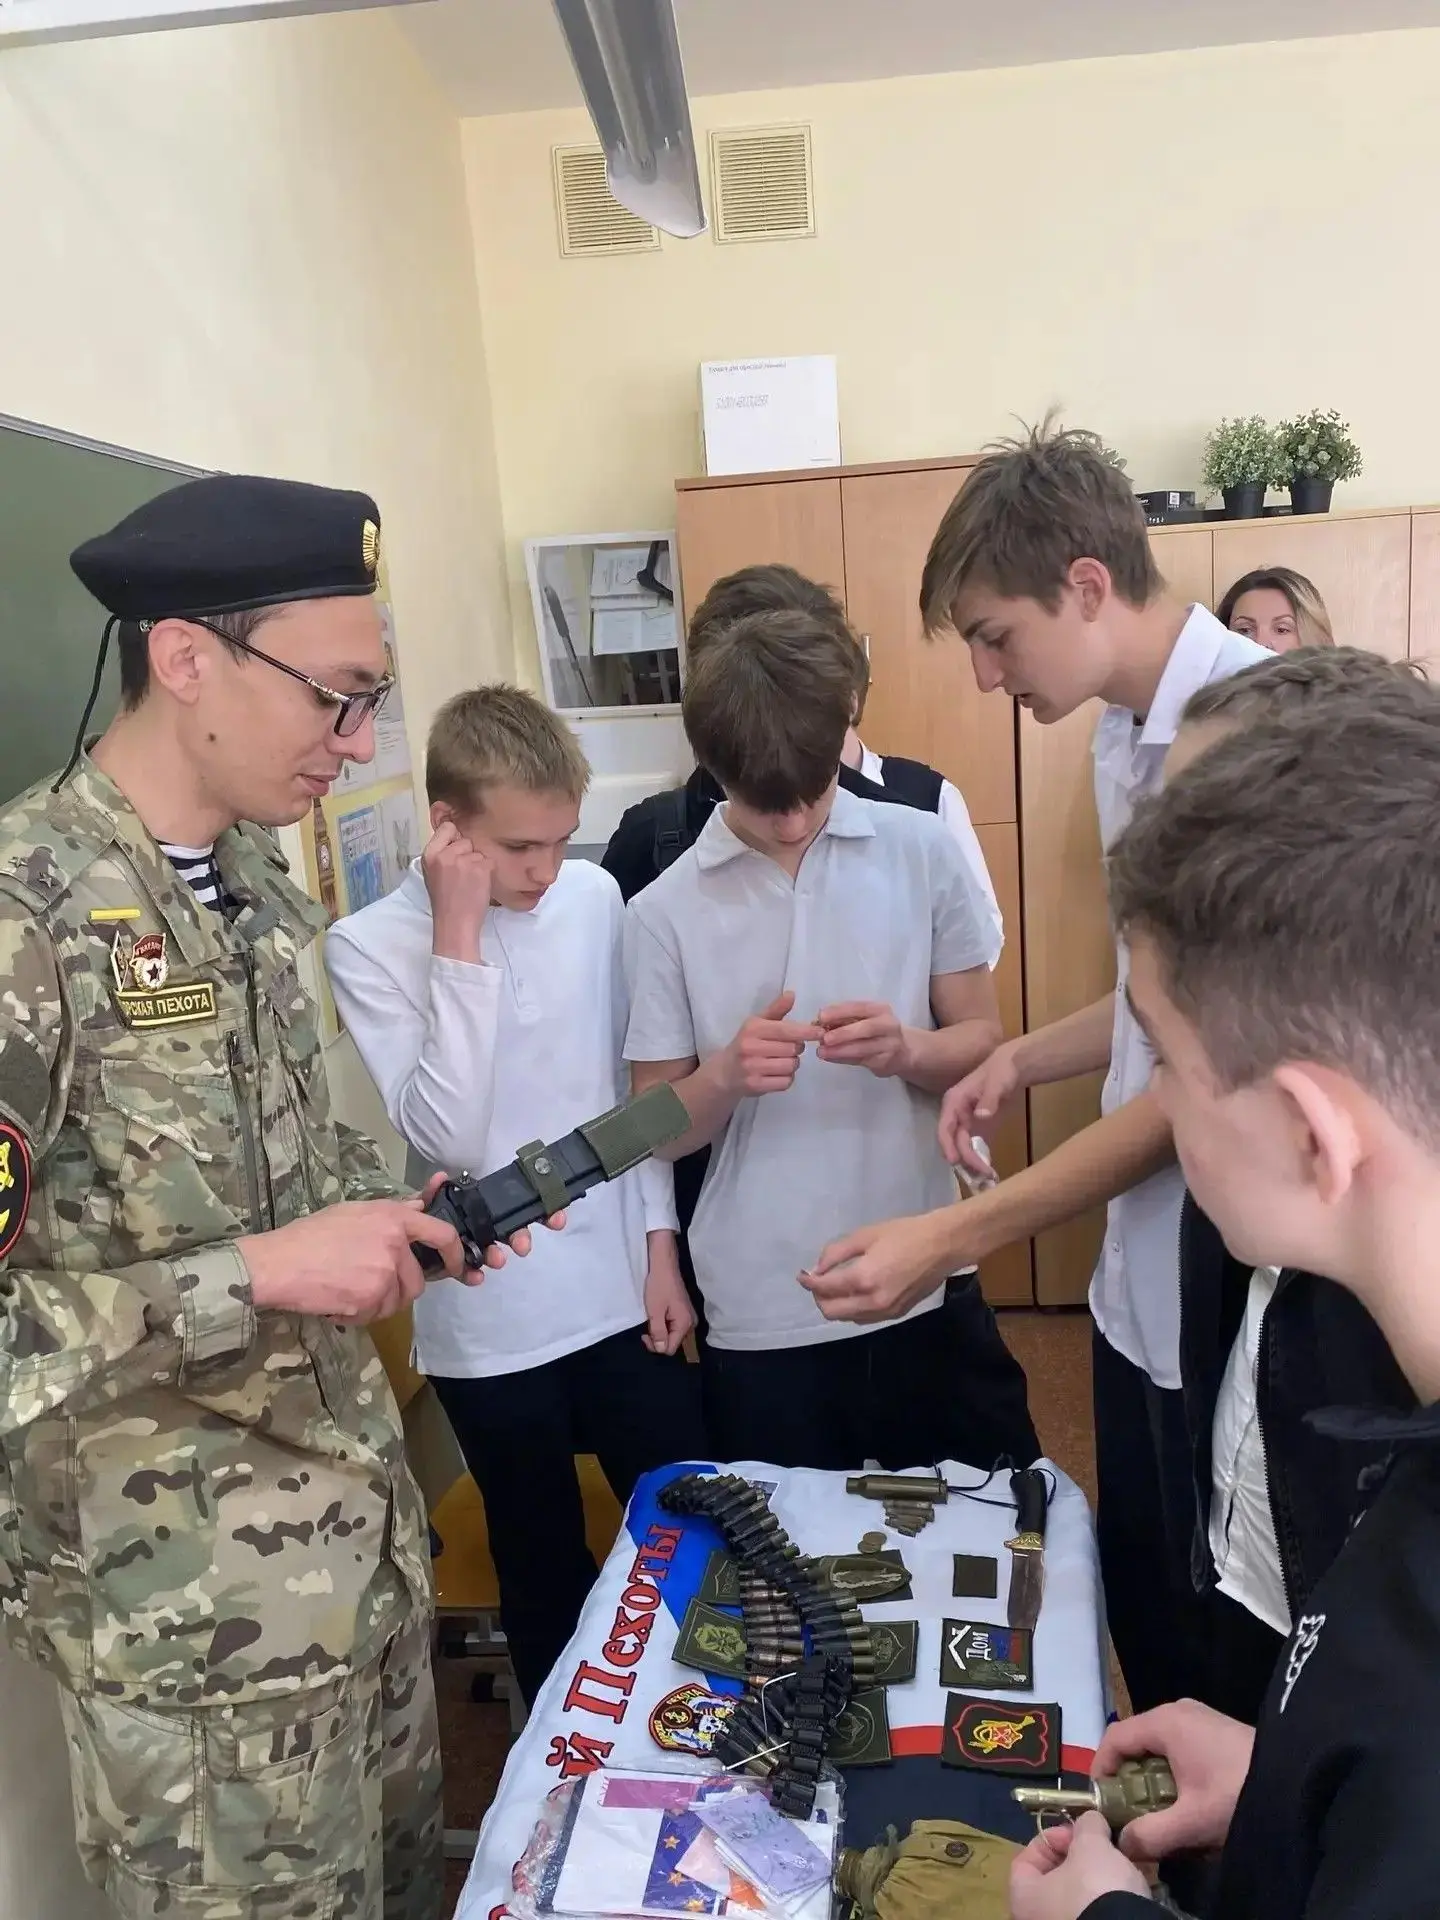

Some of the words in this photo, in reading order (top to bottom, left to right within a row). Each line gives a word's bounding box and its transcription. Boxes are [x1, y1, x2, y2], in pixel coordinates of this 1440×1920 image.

[157, 993, 210, 1015] ПЕХОТА
[562, 1523, 685, 1725] Пехоты
[965, 1631, 992, 1661] Дом
